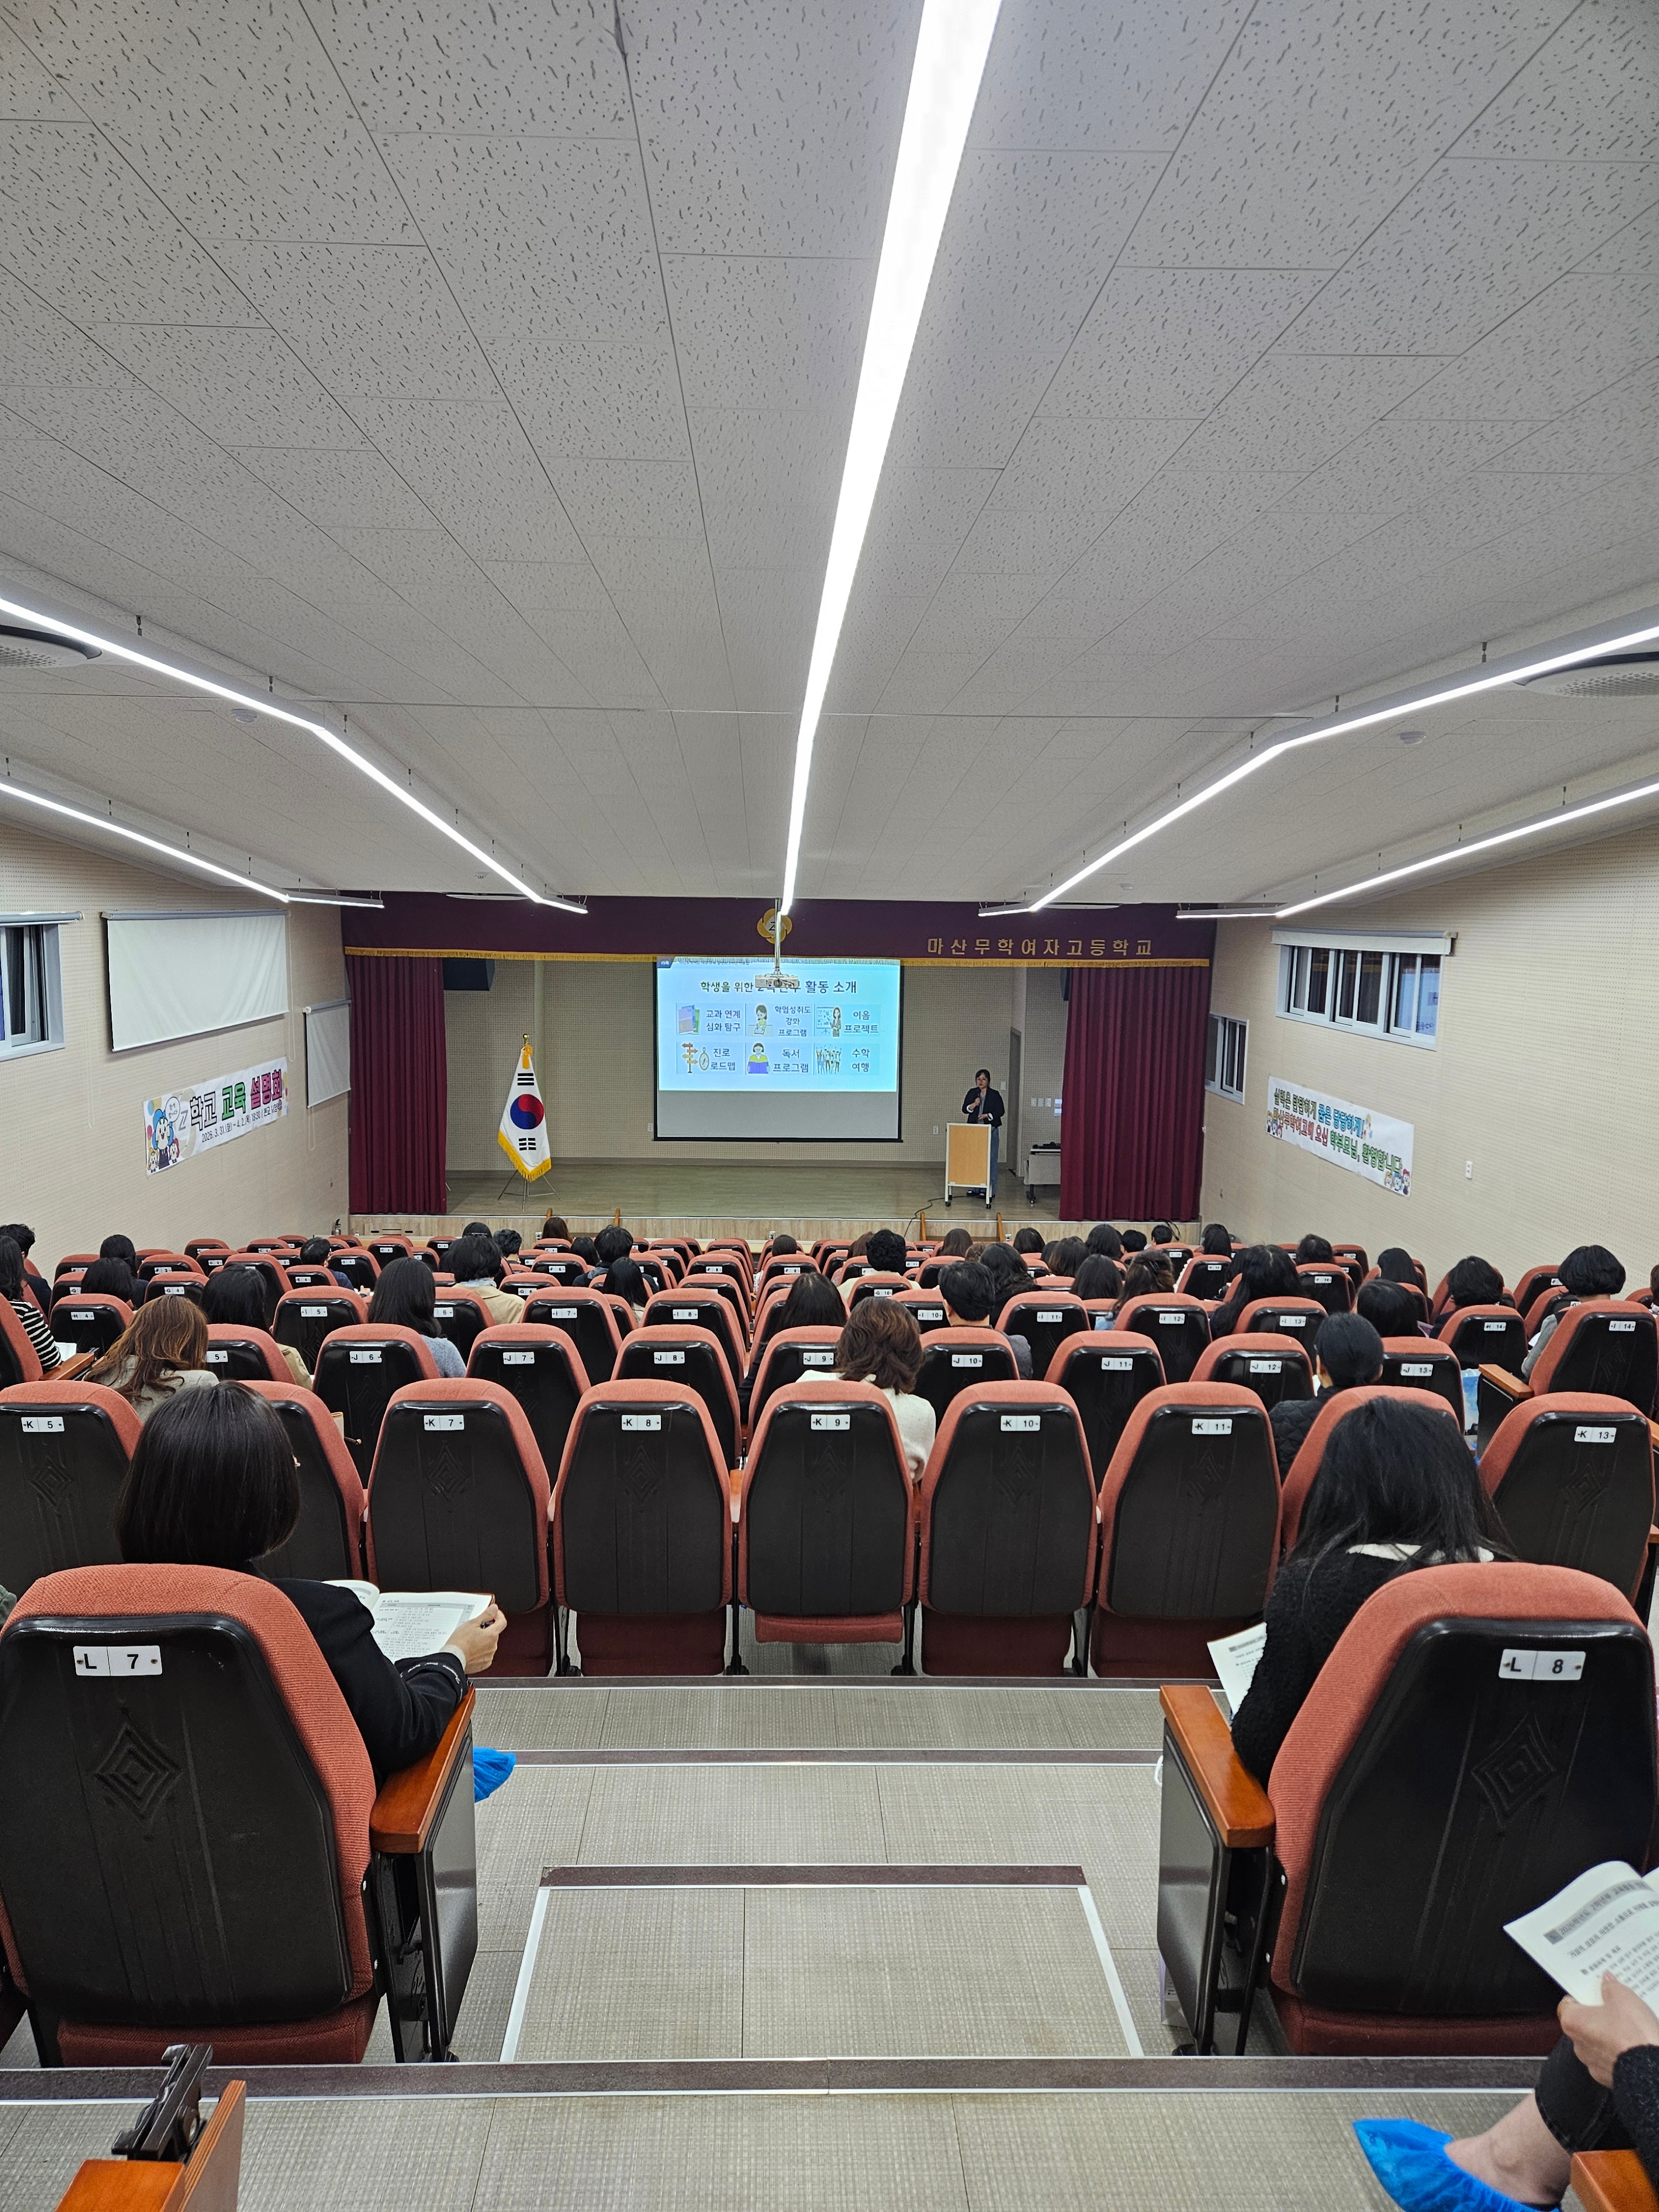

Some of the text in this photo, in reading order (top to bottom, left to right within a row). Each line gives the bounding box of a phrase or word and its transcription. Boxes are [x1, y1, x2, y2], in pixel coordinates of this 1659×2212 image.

[927, 938, 1151, 956] 마산무학여자고등학교
[700, 981, 731, 993] 학생을
[734, 982, 754, 993] 위한
[805, 980, 829, 994] 활동
[833, 980, 857, 994] 소개
[706, 1010, 741, 1019] 교과 연계
[774, 1005, 811, 1014] 학업성취도
[853, 1010, 870, 1020] 이음
[706, 1022, 741, 1032] 심화 탐구
[785, 1018, 800, 1026] 강화
[778, 1029, 807, 1037] 프로그램
[844, 1025, 879, 1034] 프로젝트
[713, 1048, 731, 1058] 진로
[782, 1049, 800, 1058] 독서
[852, 1048, 870, 1058] 수학
[710, 1062, 735, 1071] 로드맵
[773, 1063, 809, 1073] 프로그램
[852, 1062, 869, 1072] 여행
[190, 1091, 217, 1131] 학교
[221, 1082, 246, 1121] 교육
[250, 1069, 283, 1110] 설명회
[1318, 1103, 1332, 1126] 꿈은
[202, 1132, 213, 1143] 2026.
[1315, 1125, 1328, 1147] 오신
[84, 1653, 138, 1669] L 7
[1510, 1657, 1563, 1674] L 8
